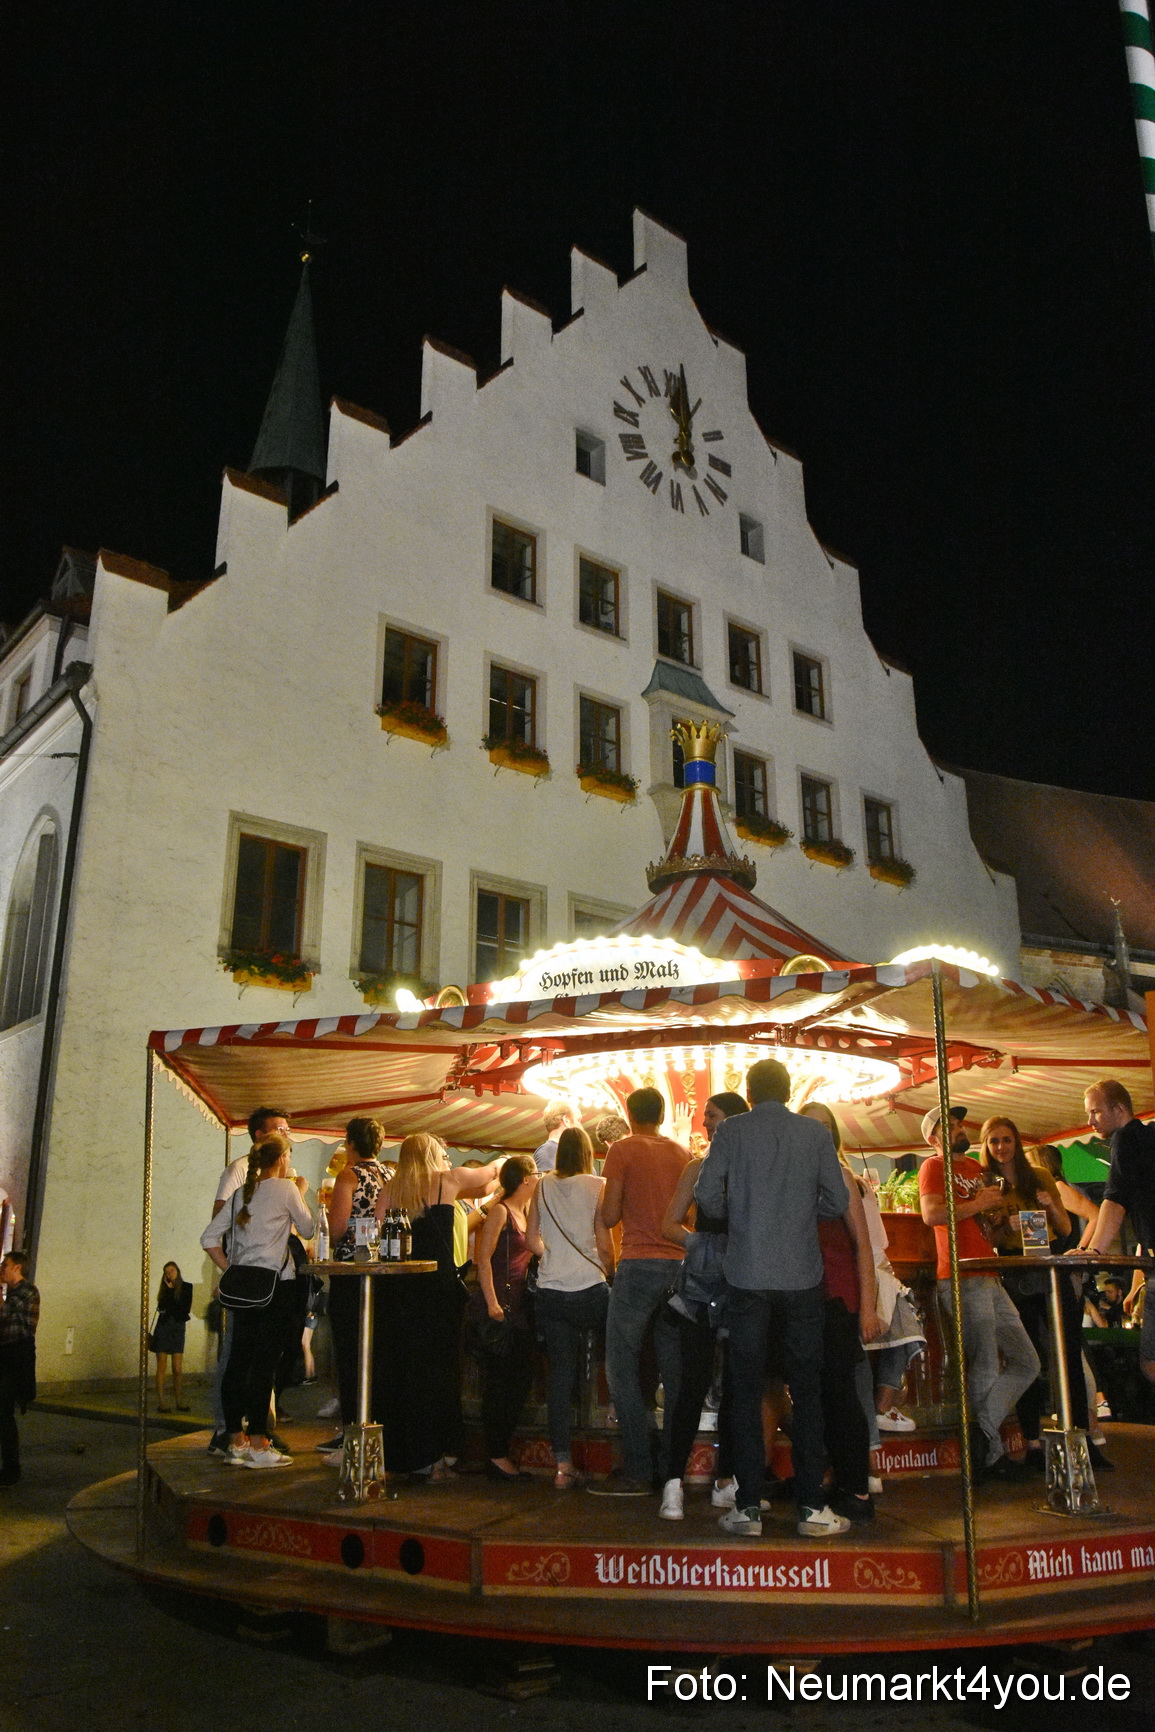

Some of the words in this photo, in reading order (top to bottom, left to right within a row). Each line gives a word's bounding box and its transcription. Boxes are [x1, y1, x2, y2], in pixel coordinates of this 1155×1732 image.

[539, 968, 594, 992] Hopfen
[599, 963, 629, 983] und
[634, 960, 679, 980] Malz
[594, 1553, 831, 1588] Weißbierkarussell
[1026, 1548, 1074, 1580] Mich
[1081, 1545, 1124, 1574] kann
